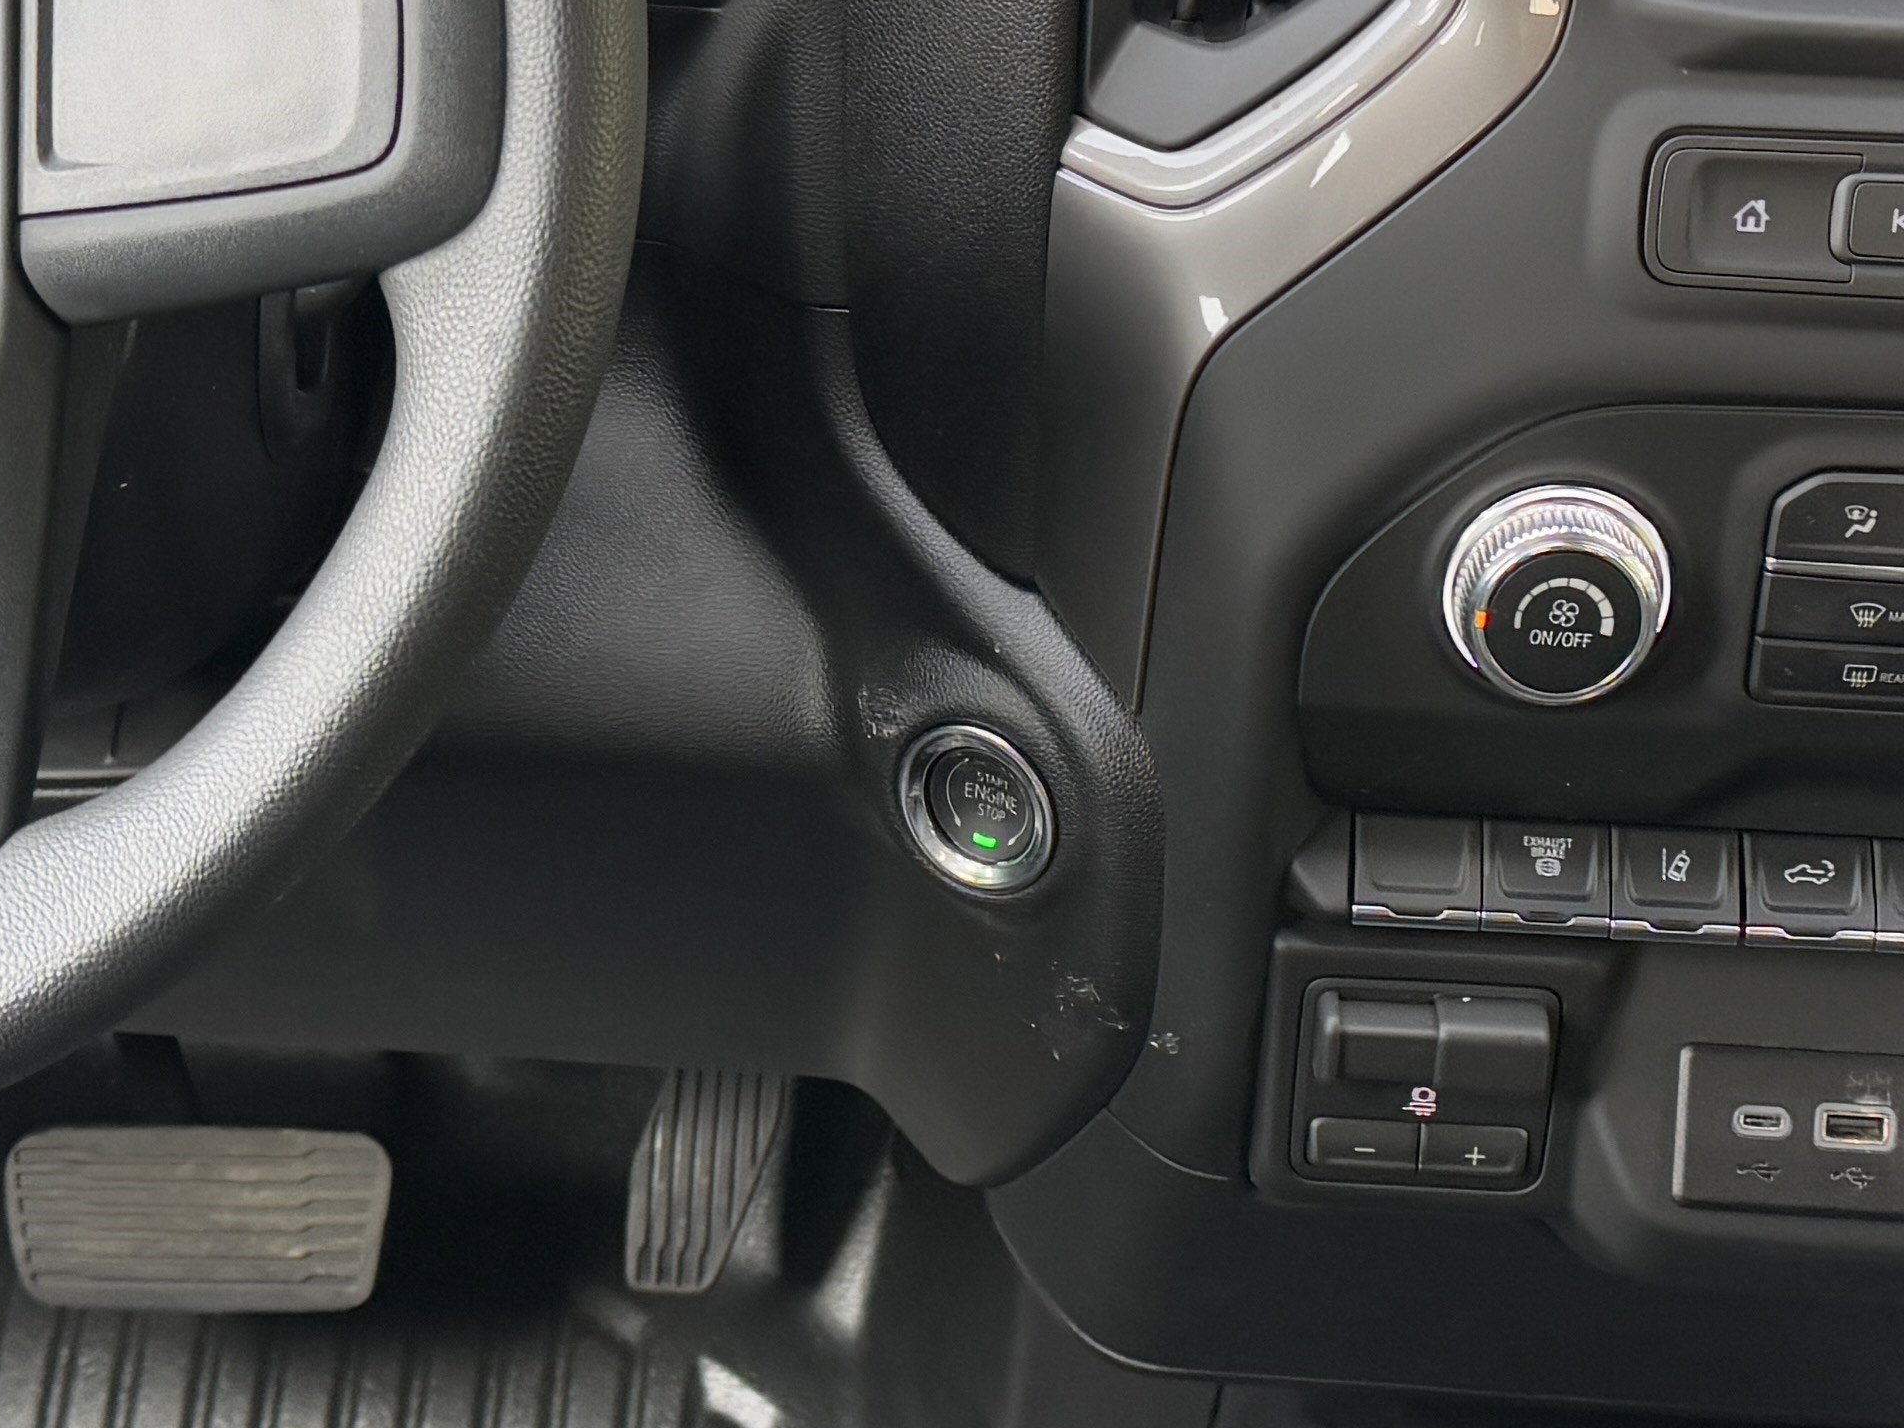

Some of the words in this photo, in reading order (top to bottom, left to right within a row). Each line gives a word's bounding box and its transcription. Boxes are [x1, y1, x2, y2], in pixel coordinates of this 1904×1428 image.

[1529, 628, 1594, 649] ON/OFF
[977, 771, 1008, 791] START
[964, 781, 1018, 816] ENGINE
[977, 803, 1006, 821] STOP
[1523, 835, 1573, 850] EXHAUST
[1530, 846, 1566, 860] BRAKE
